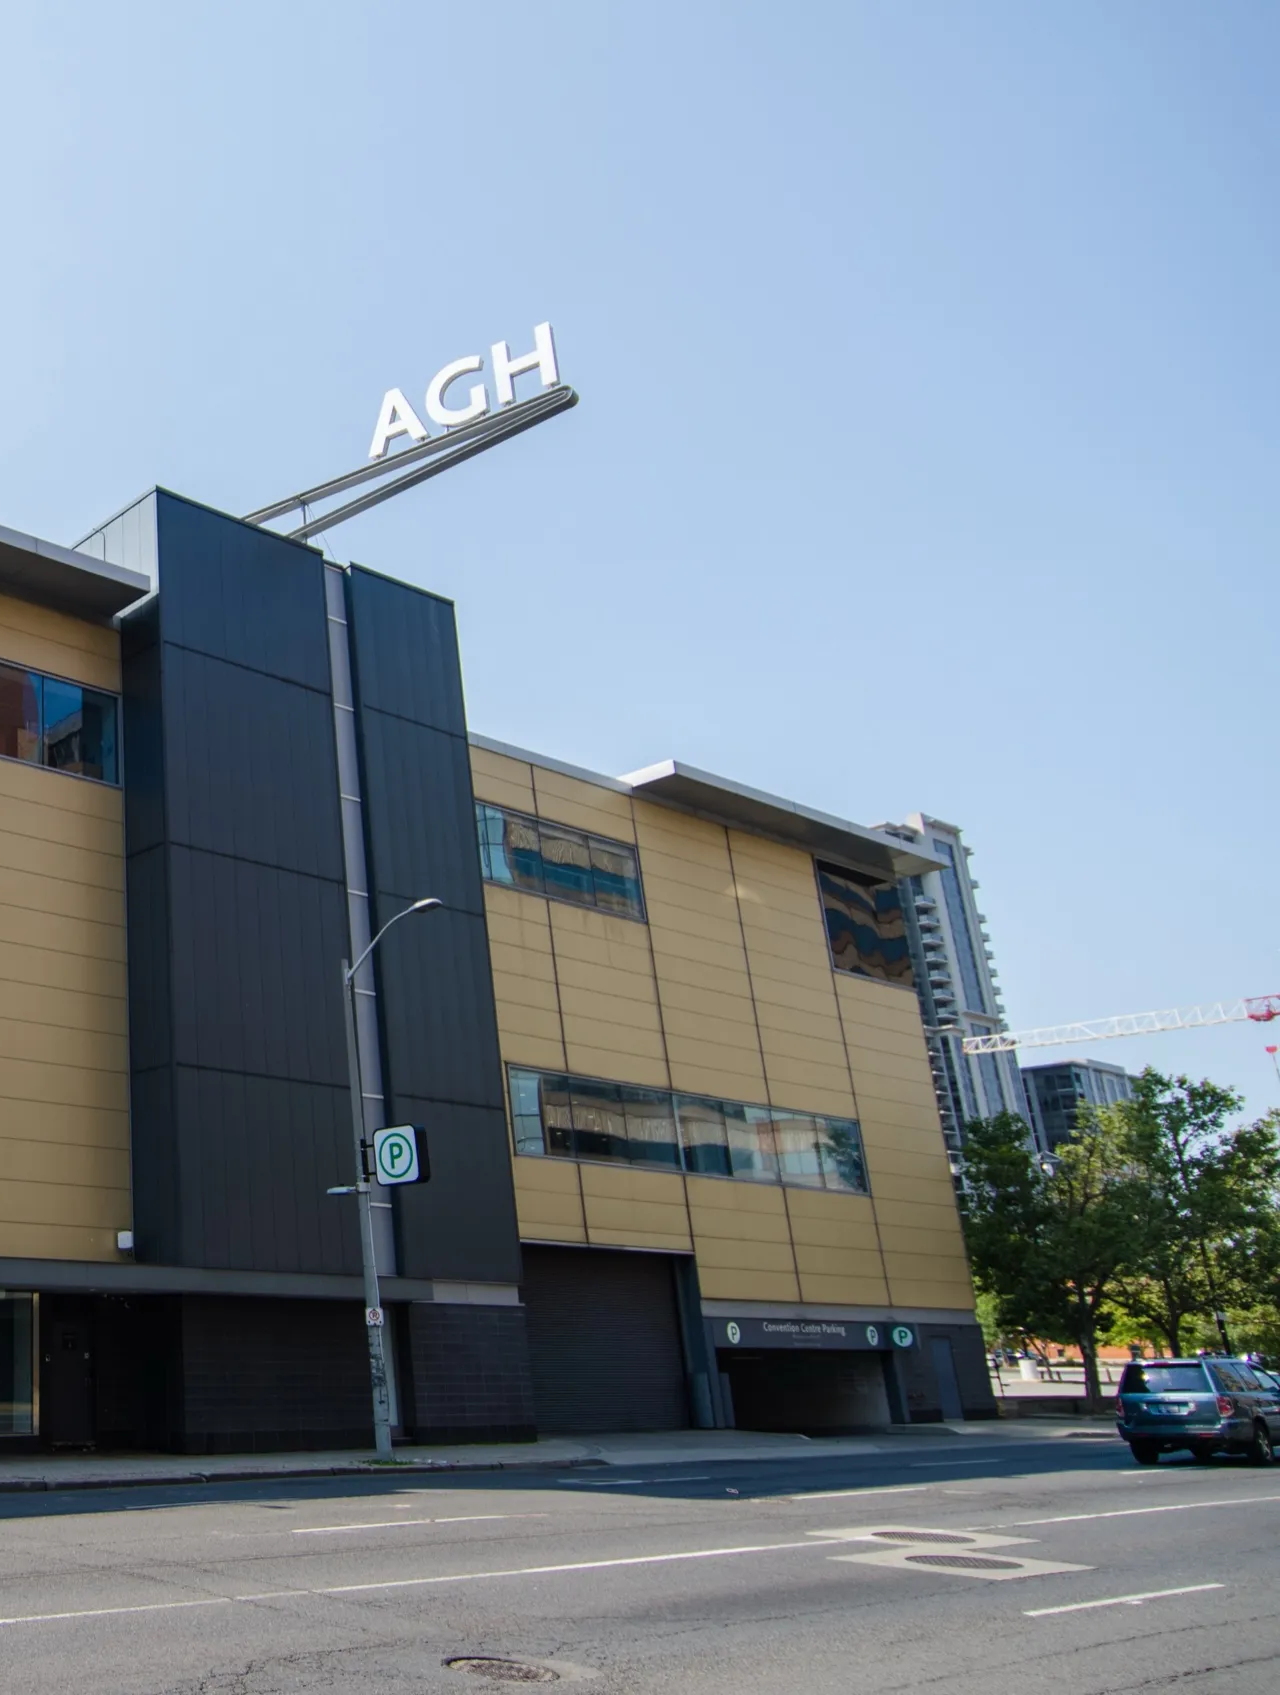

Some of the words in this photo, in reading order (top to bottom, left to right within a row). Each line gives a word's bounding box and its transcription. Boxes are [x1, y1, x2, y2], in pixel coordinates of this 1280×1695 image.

[368, 321, 560, 460] AGH
[389, 1142, 403, 1169] P
[763, 1321, 800, 1333] Convention
[800, 1323, 821, 1333] Centre
[822, 1324, 846, 1337] Parking
